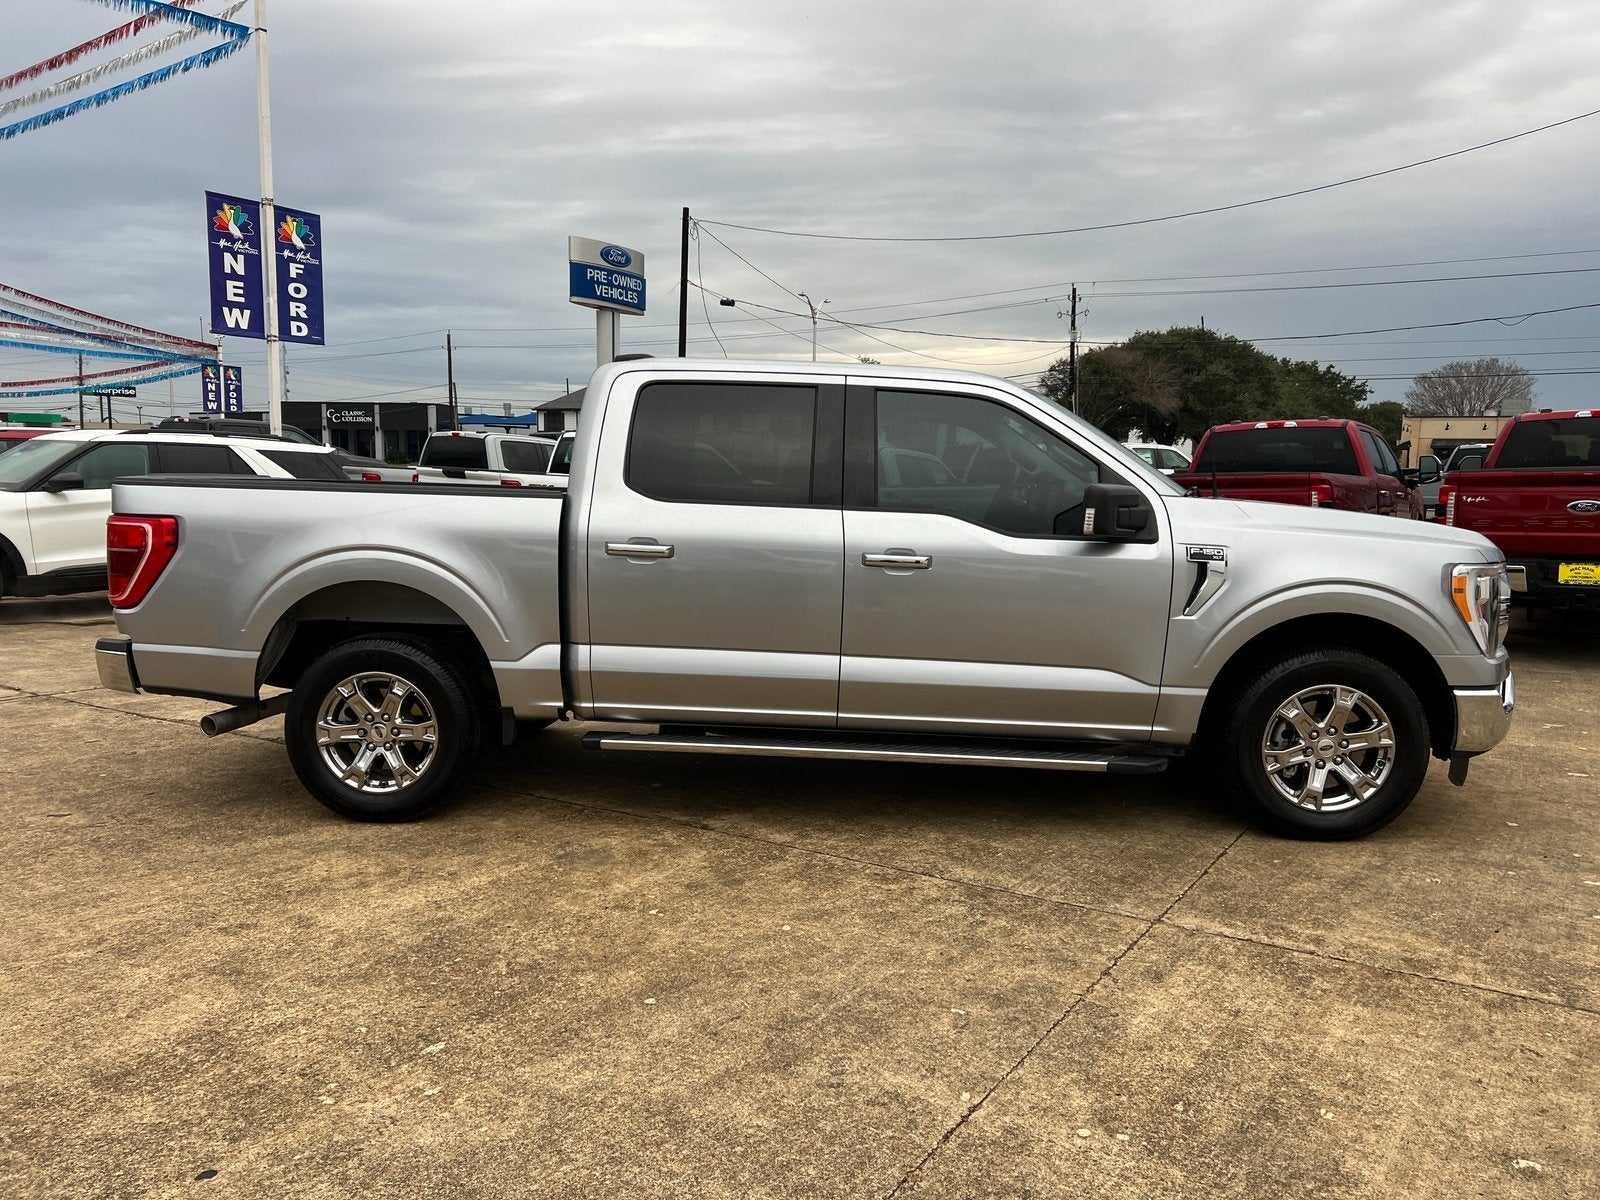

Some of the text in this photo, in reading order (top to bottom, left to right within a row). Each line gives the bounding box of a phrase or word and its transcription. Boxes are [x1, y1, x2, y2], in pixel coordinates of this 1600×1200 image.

[608, 249, 626, 263] Ford
[222, 252, 250, 329] NEW
[288, 263, 308, 336] FORD
[595, 284, 638, 303] VEHICLES
[207, 382, 217, 411] NEW
[229, 384, 238, 412] FORD
